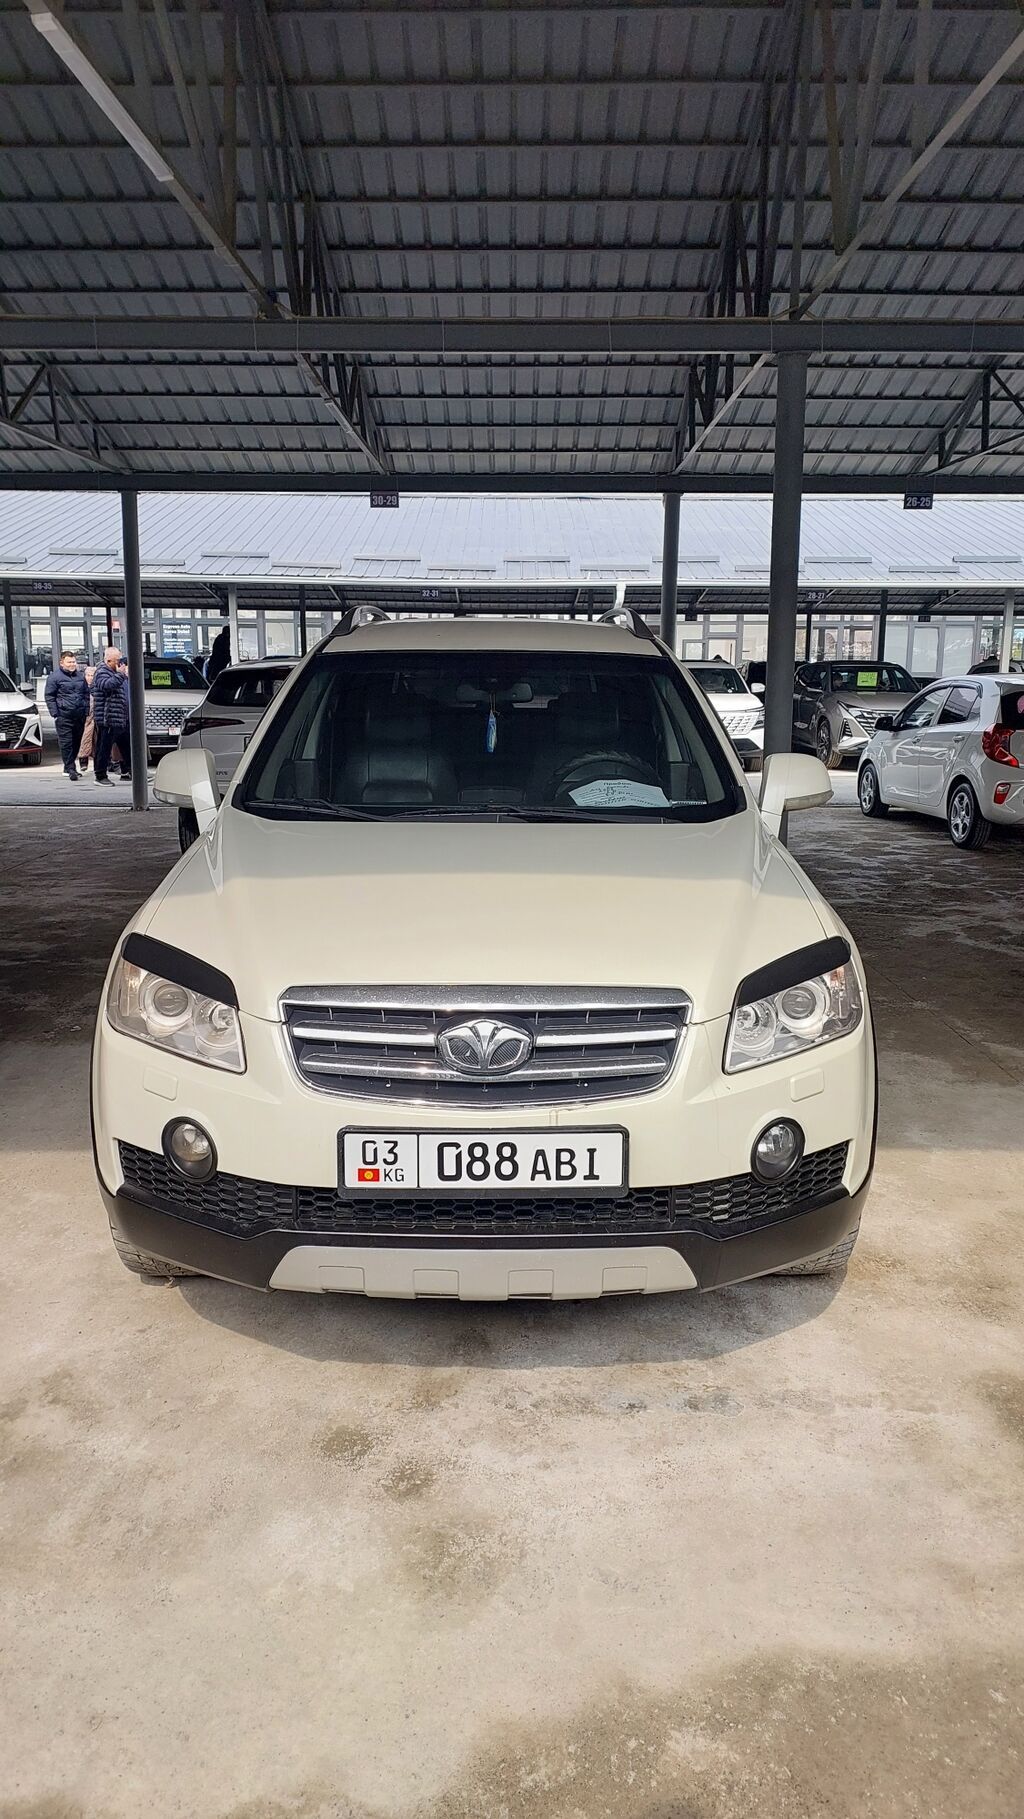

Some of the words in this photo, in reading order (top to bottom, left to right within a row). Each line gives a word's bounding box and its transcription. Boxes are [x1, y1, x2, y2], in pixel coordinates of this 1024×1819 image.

[372, 495, 398, 505] 30-29
[906, 497, 931, 507] 26-25
[361, 1140, 399, 1166] 03
[437, 1141, 519, 1182] 088
[530, 1148, 600, 1181] ABI
[383, 1168, 405, 1182] KG
